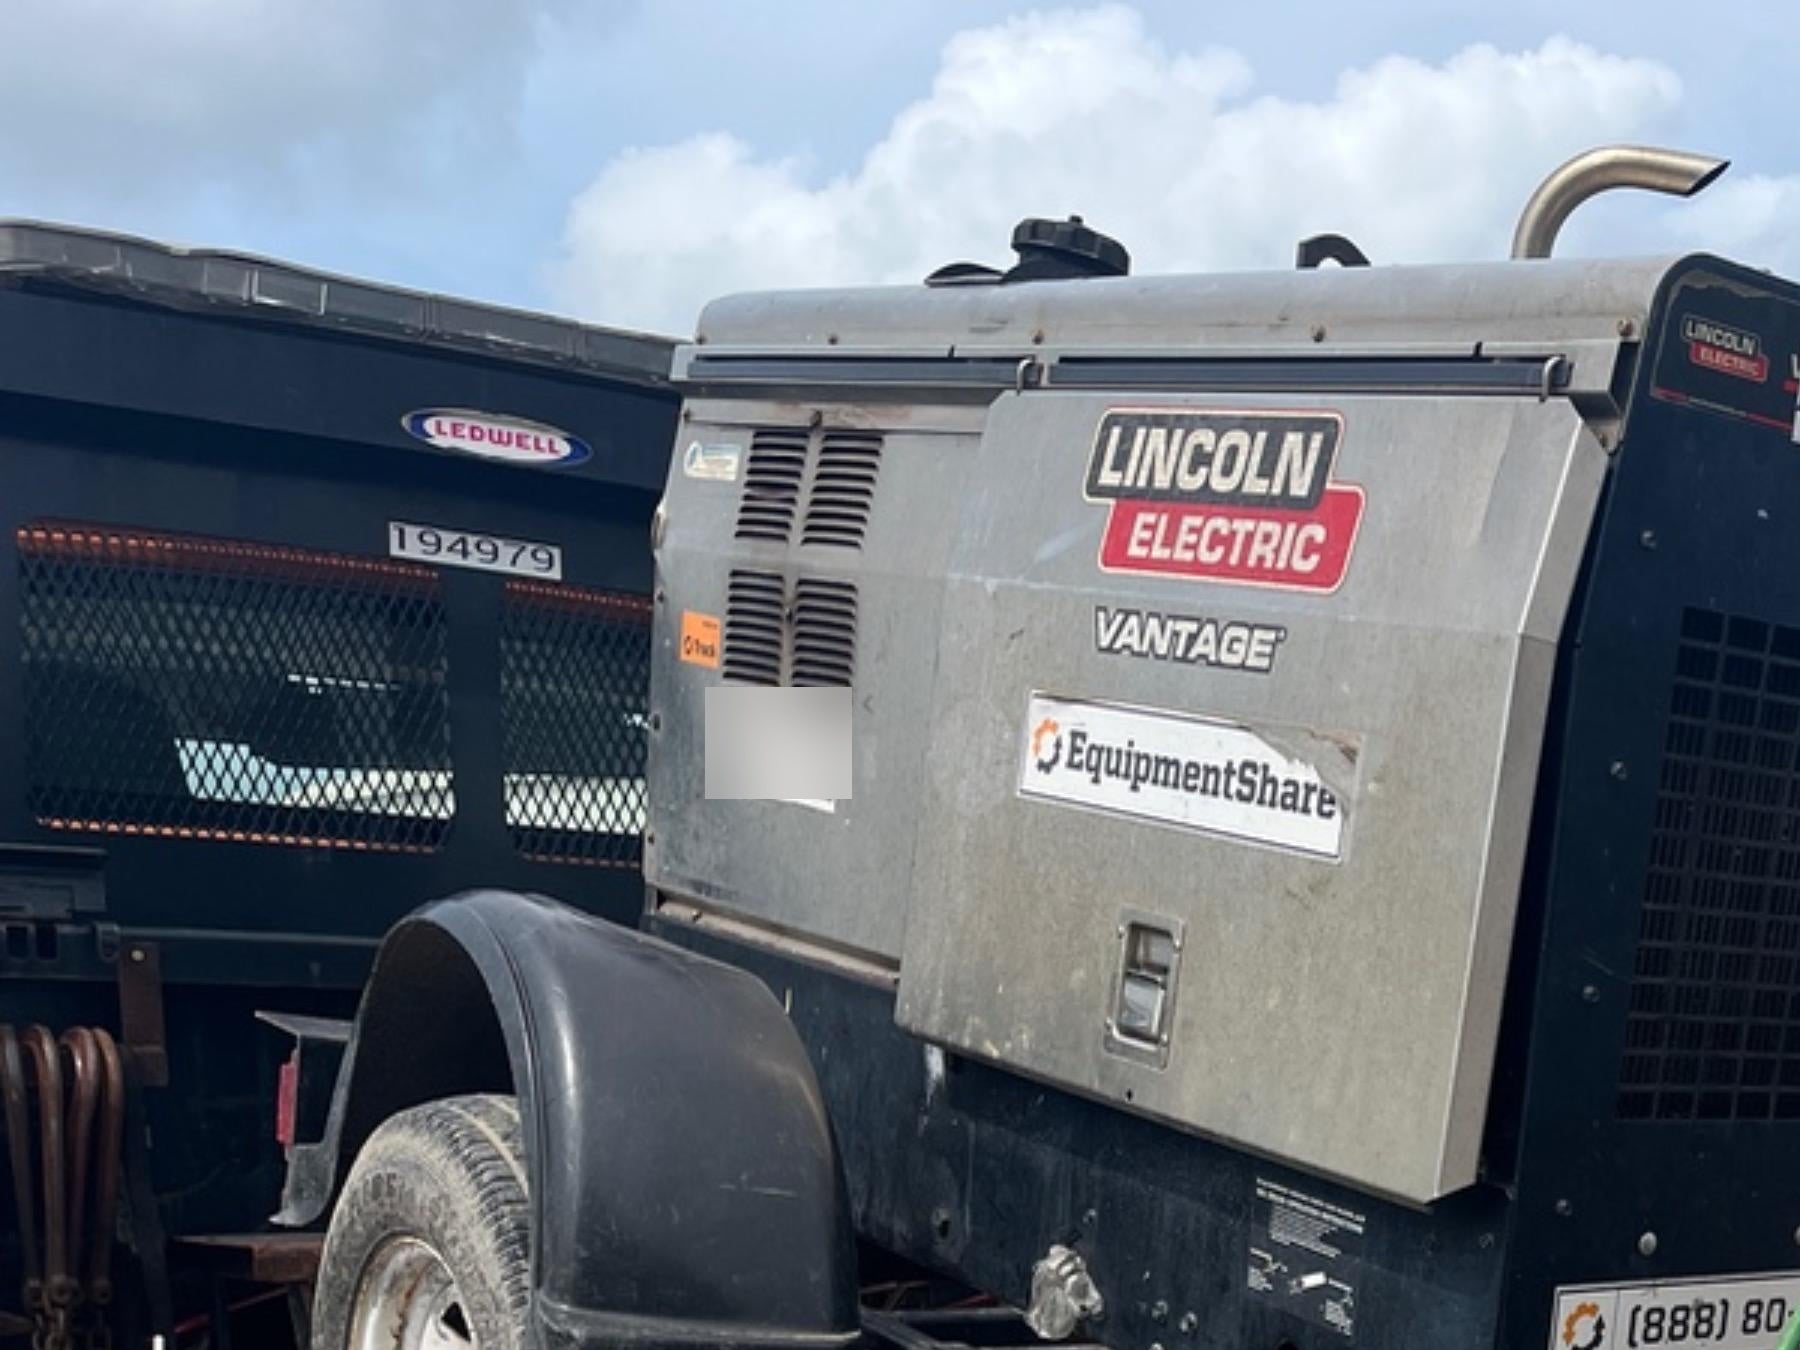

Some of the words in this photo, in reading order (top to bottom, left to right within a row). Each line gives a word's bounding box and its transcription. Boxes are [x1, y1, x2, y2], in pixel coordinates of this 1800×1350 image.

[1686, 319, 1755, 356] LINCOLN
[434, 419, 561, 454] LEDWELL
[1098, 425, 1324, 497] LINCOLN
[393, 524, 555, 572] 194979
[1127, 511, 1327, 573] ELECTRIC
[1096, 608, 1281, 672] VANTAGE
[1065, 729, 1337, 819] EquipmentShare
[1628, 1298, 1729, 1348] (888)
